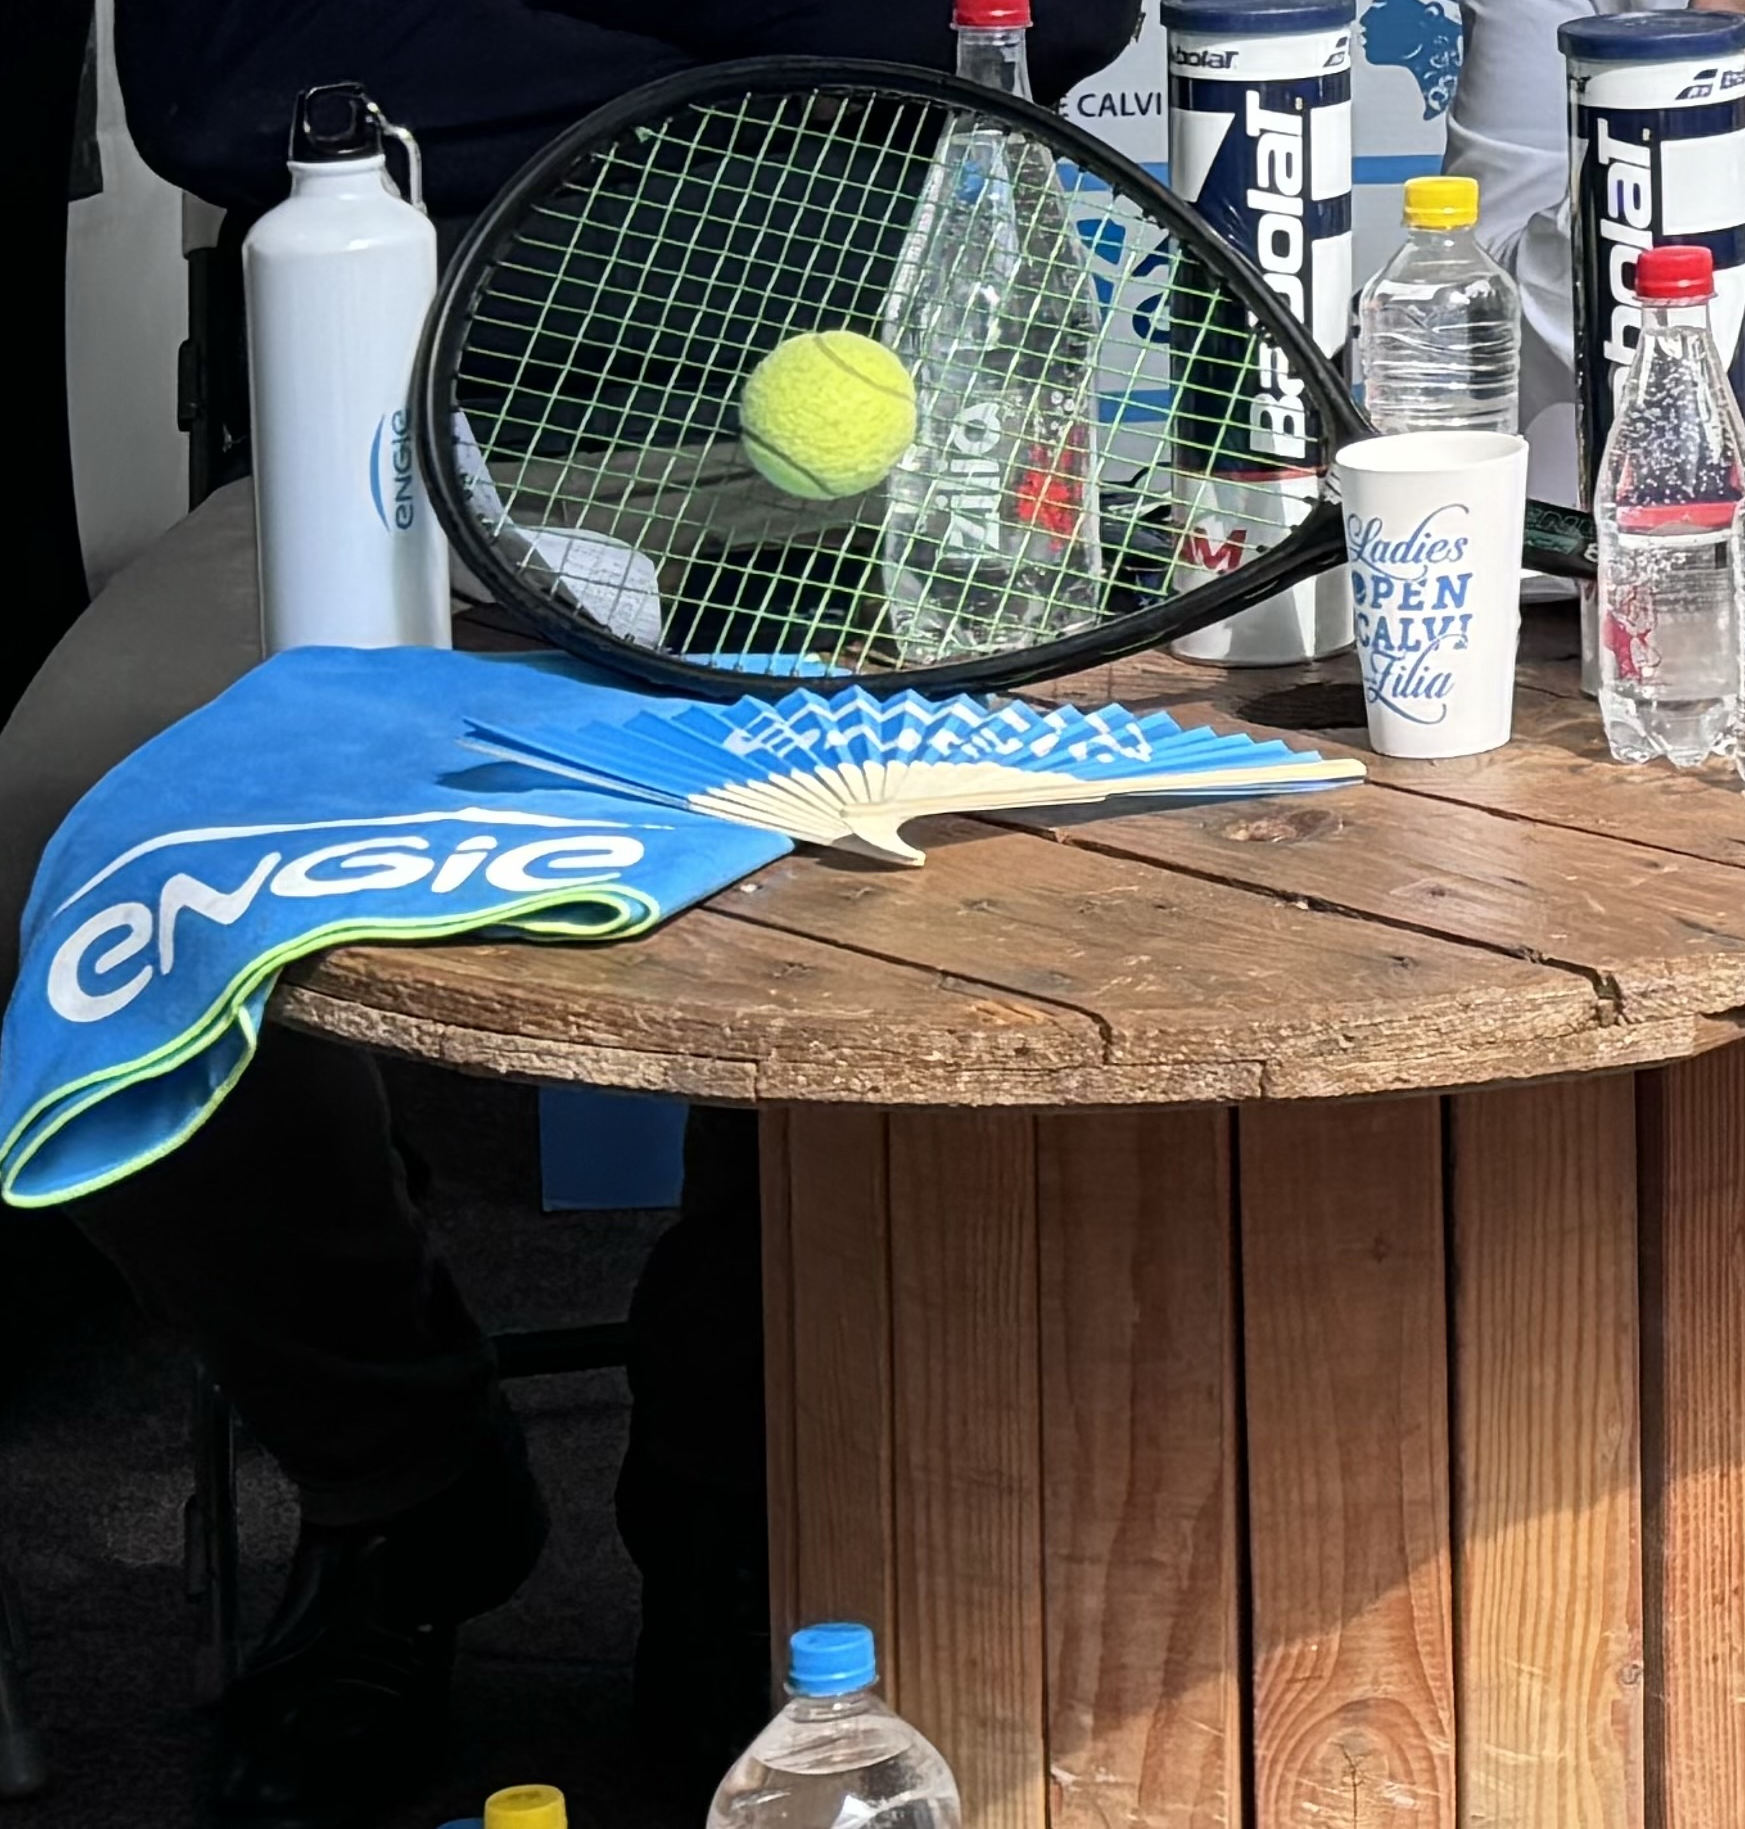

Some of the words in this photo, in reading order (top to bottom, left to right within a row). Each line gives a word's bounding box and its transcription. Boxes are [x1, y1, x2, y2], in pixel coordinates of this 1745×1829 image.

[1077, 92, 1163, 120] CALVI
[1347, 503, 1470, 581] Ladies
[1352, 571, 1474, 612] OPEN
[1355, 612, 1473, 652] CALVI
